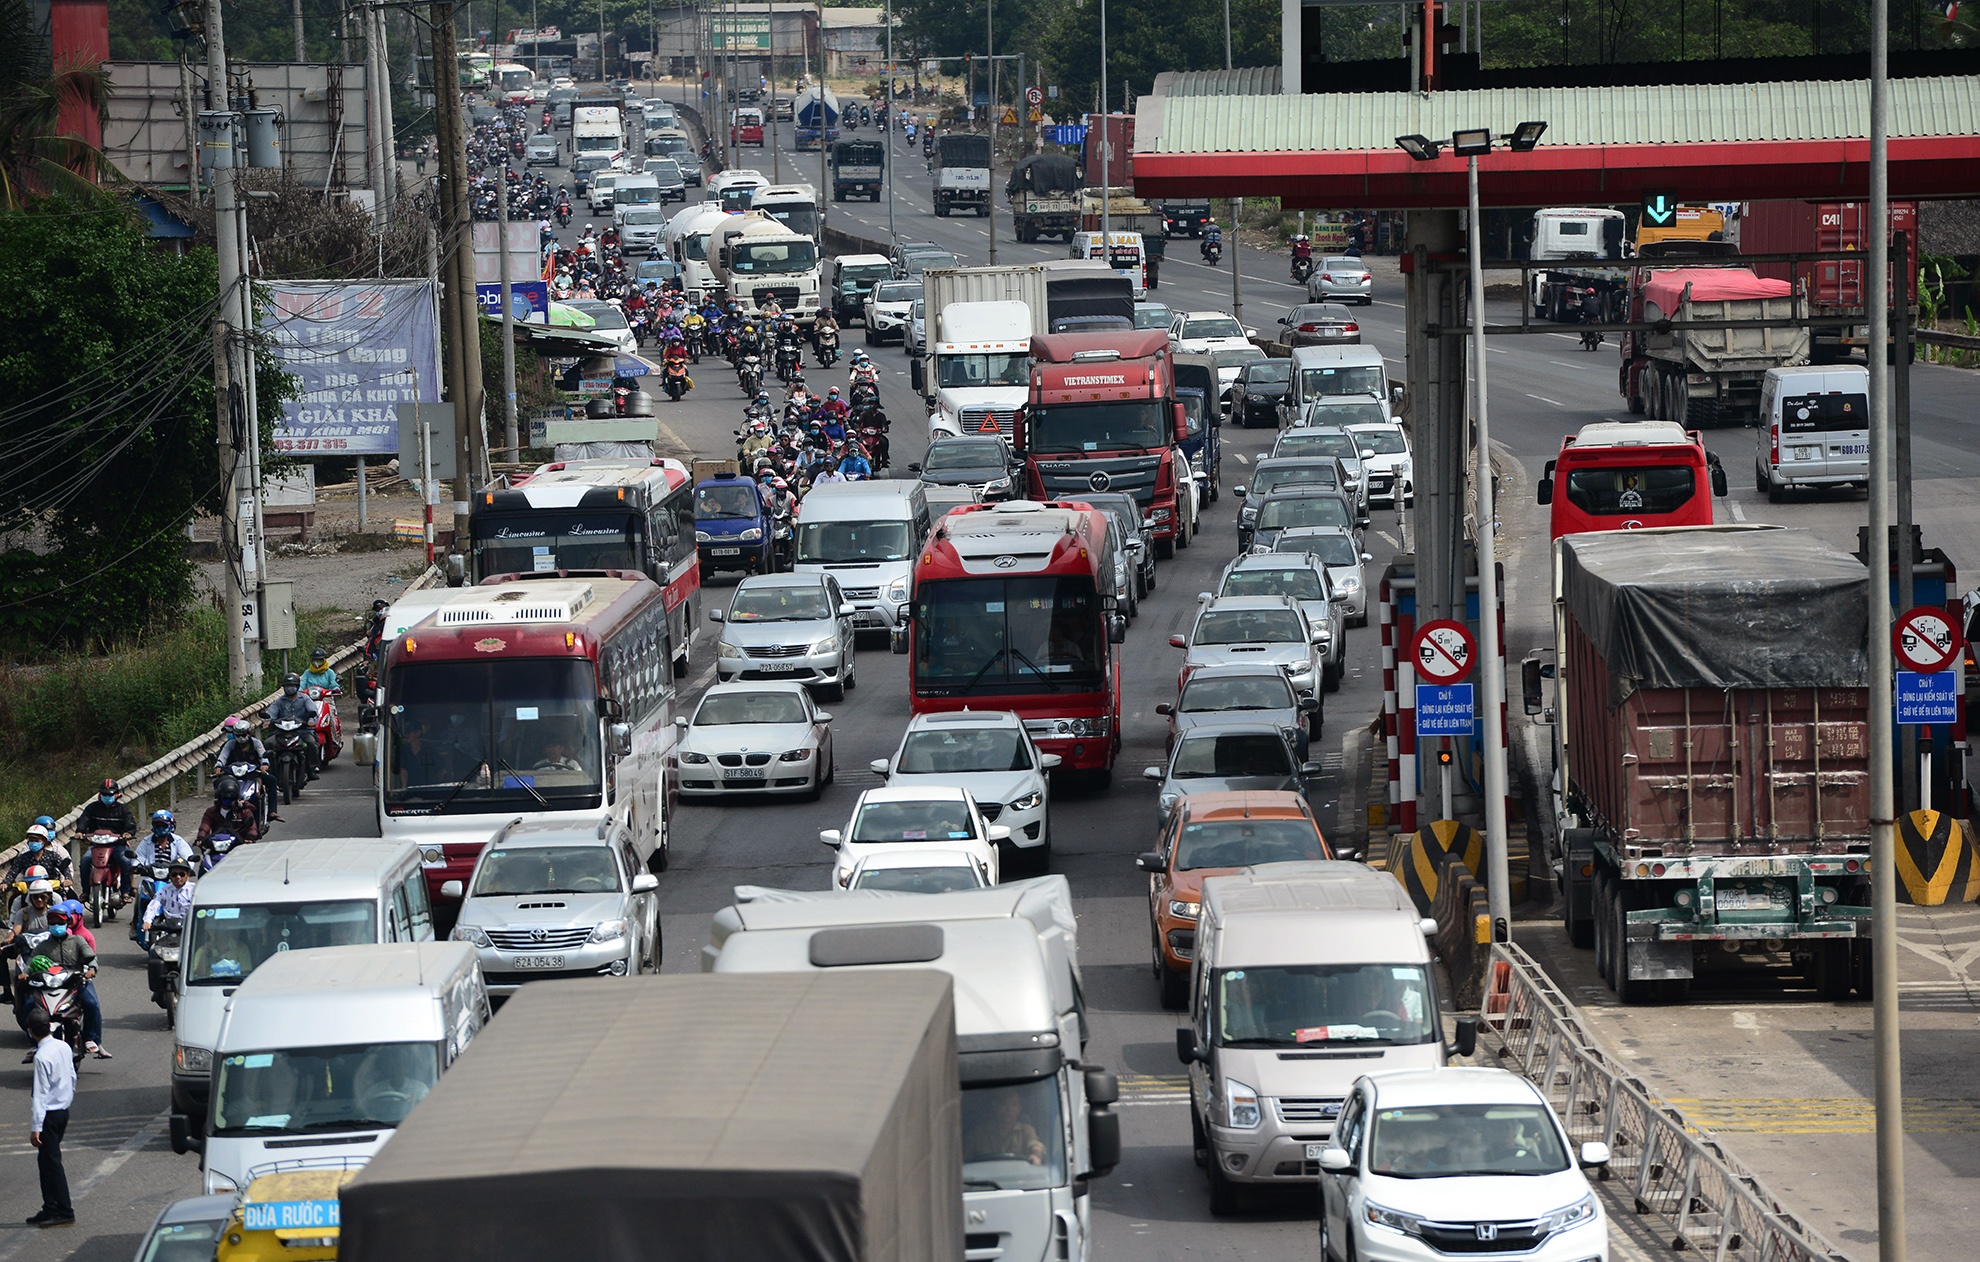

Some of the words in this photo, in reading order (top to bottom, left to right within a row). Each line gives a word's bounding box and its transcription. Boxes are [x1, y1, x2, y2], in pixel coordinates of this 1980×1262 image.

[1822, 214, 1840, 225] CAI
[1116, 236, 1137, 245] MAI
[356, 291, 385, 318] 2
[284, 348, 339, 364] Nam
[348, 347, 407, 363] Vang
[1064, 375, 1124, 386] VIETRANSTIMEX
[367, 389, 398, 401] KHO
[351, 404, 398, 422] KHÁ
[323, 438, 347, 450] 315
[494, 527, 546, 539] Limousine
[568, 523, 620, 536] Limousine
[1920, 623, 1926, 633] 5
[1437, 634, 1443, 644] 5
[1723, 890, 1740, 899] 70R
[246, 1203, 277, 1227] ĐƯA
[282, 1201, 323, 1226] RƯỚC
